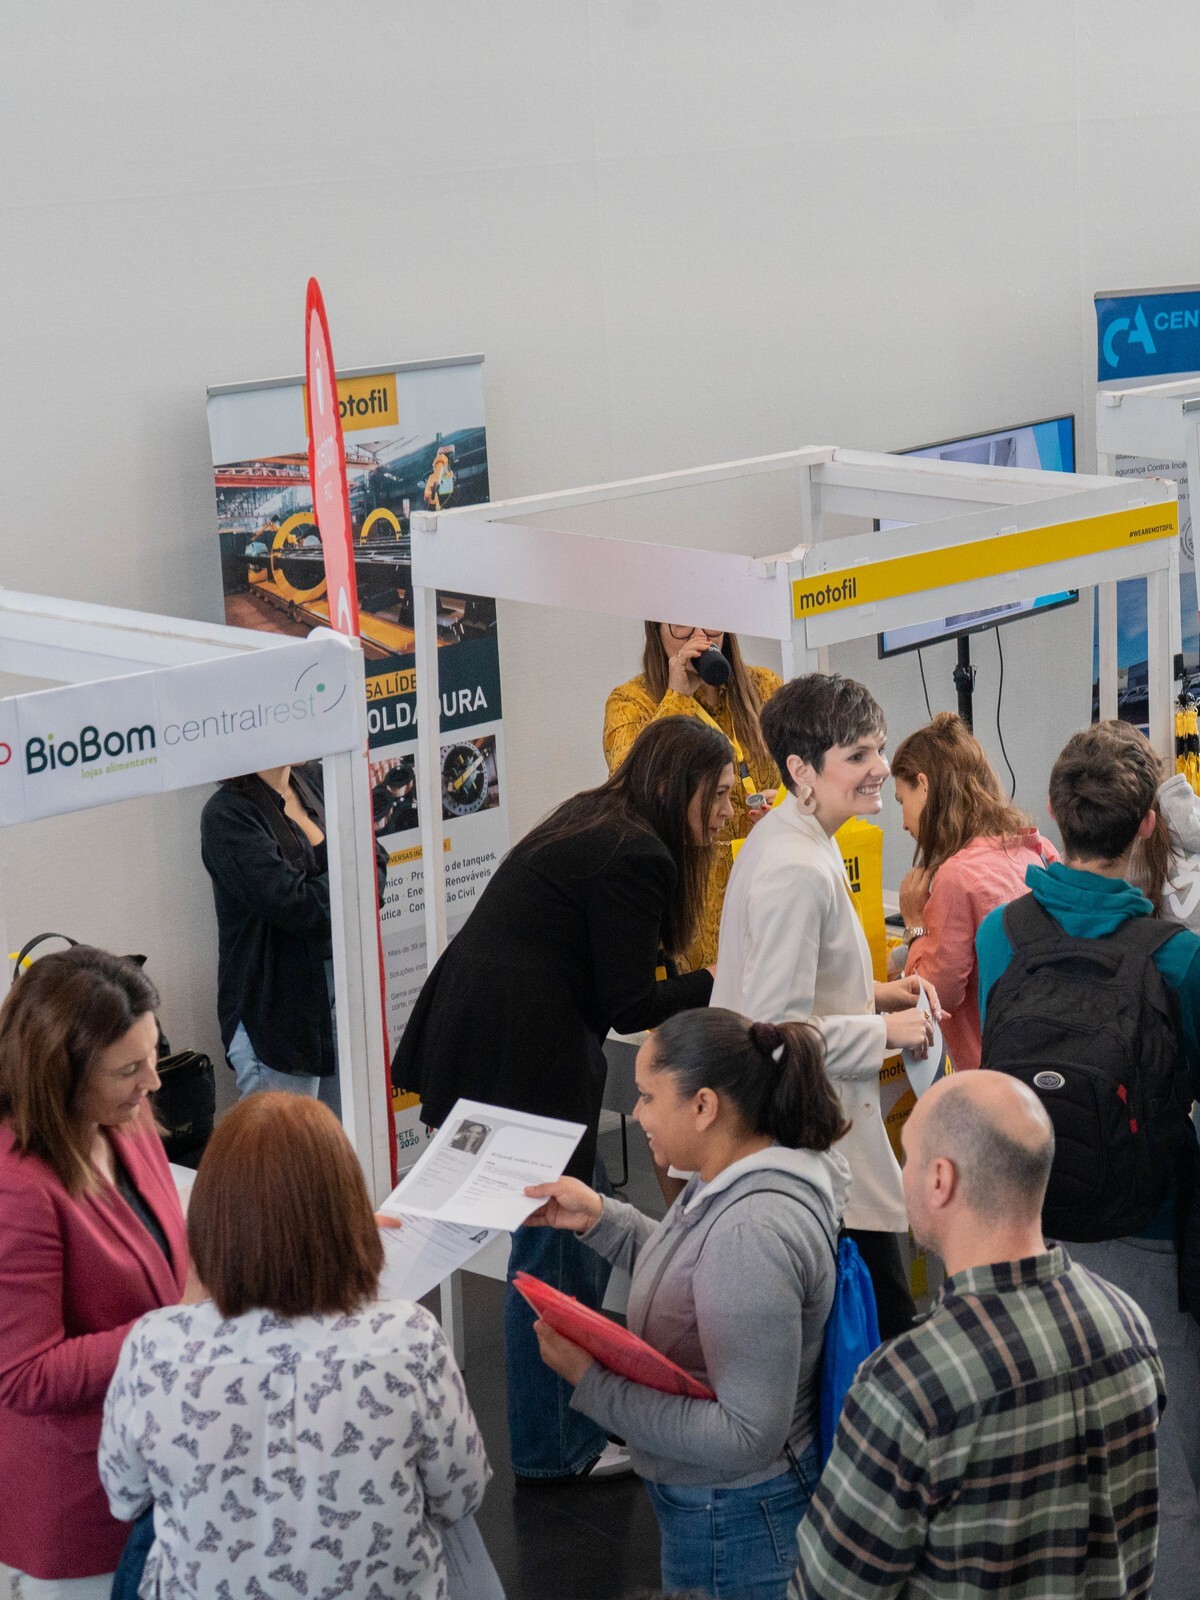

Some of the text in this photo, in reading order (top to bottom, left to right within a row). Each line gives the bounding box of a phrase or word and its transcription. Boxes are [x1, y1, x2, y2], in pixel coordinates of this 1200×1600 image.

[338, 388, 388, 419] otofil
[1115, 467, 1146, 477] egurança
[1147, 463, 1170, 472] Contra
[1129, 523, 1174, 538] #WEAREMOTOFIL
[800, 577, 857, 610] motofil
[386, 673, 417, 697] LÍDE
[26, 725, 156, 775] BioBom
[164, 693, 317, 746] centralrest
[82, 756, 158, 780] lojas alimentares
[452, 861, 461, 870] de
[463, 852, 497, 868] tanques,
[445, 867, 491, 887] Renováveis
[458, 886, 476, 899] Civil
[400, 1136, 420, 1149] 2020
